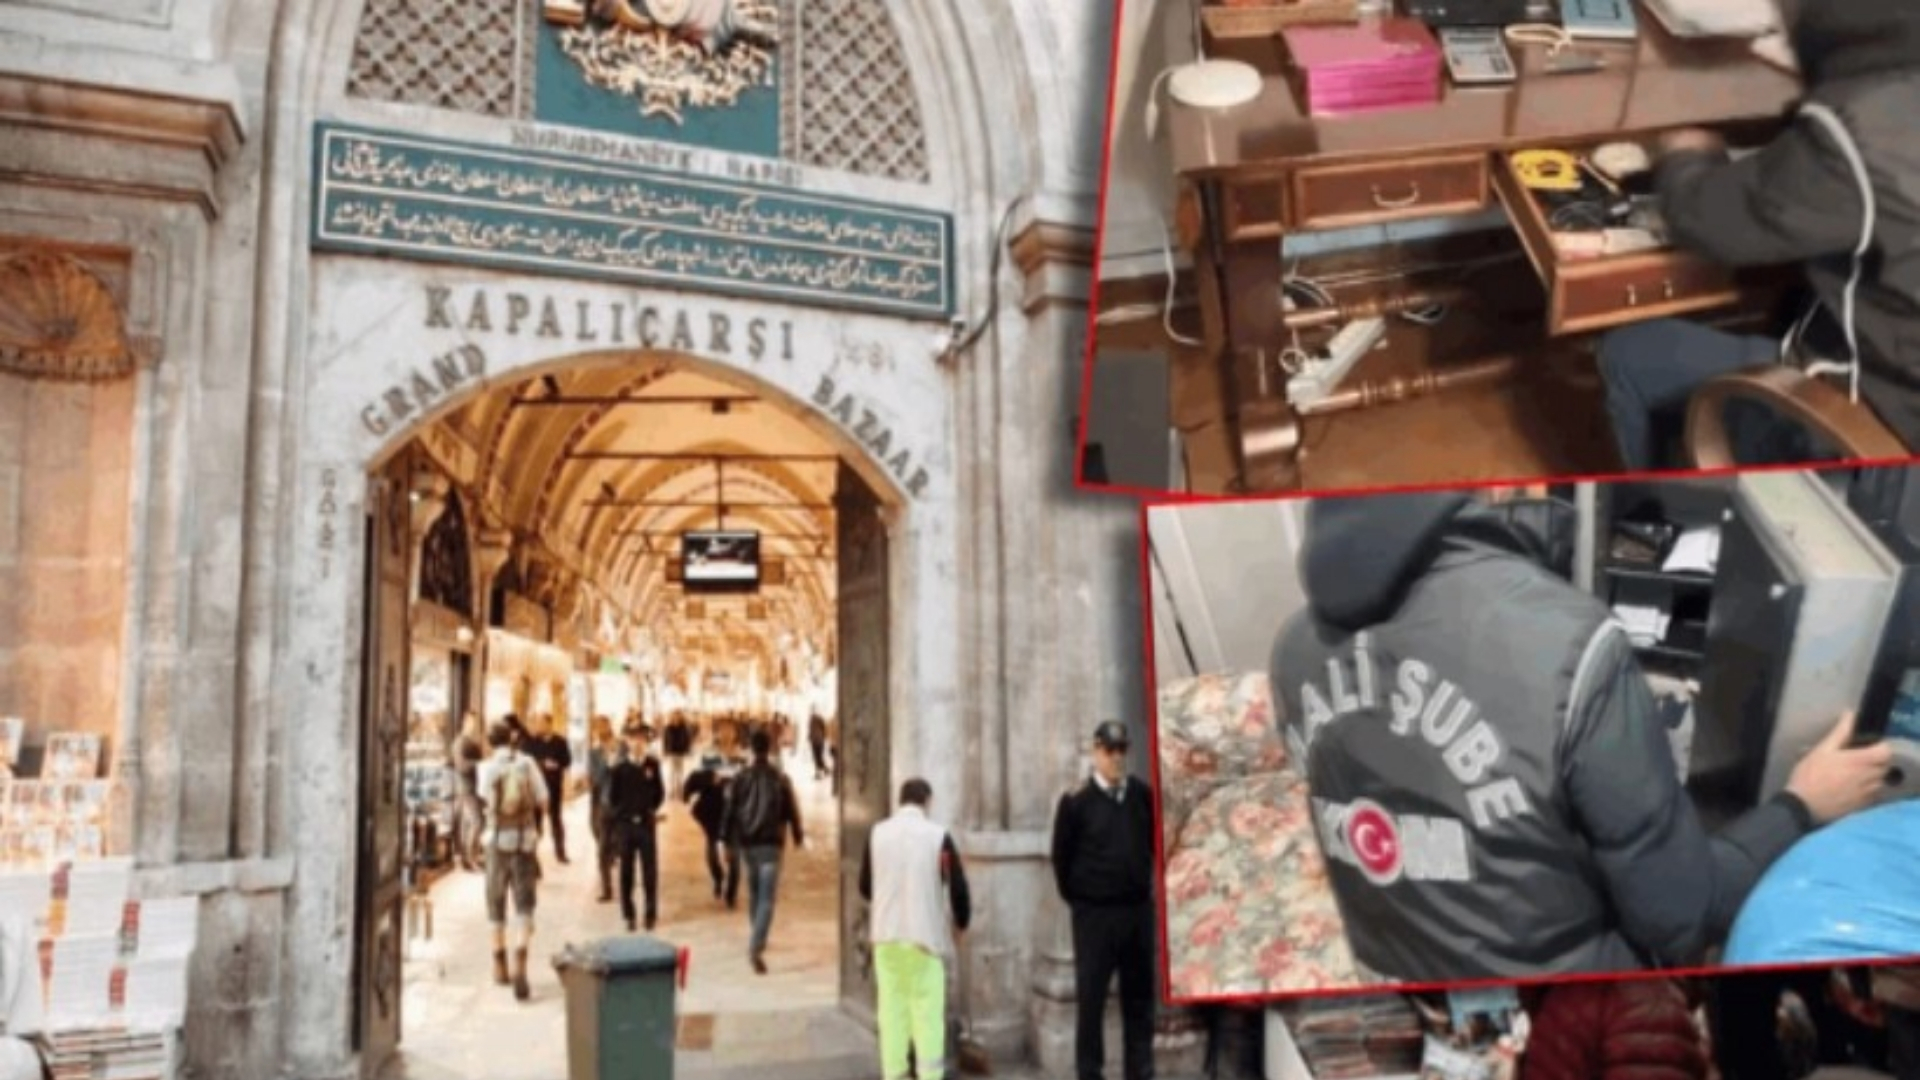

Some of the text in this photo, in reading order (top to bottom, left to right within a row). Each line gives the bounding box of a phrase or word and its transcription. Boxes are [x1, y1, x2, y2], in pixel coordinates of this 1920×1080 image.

[425, 285, 793, 361] KAPALIÇARŞI
[360, 343, 929, 498] GRAND BAZAAR
[1389, 658, 1534, 829] ŞUBE
